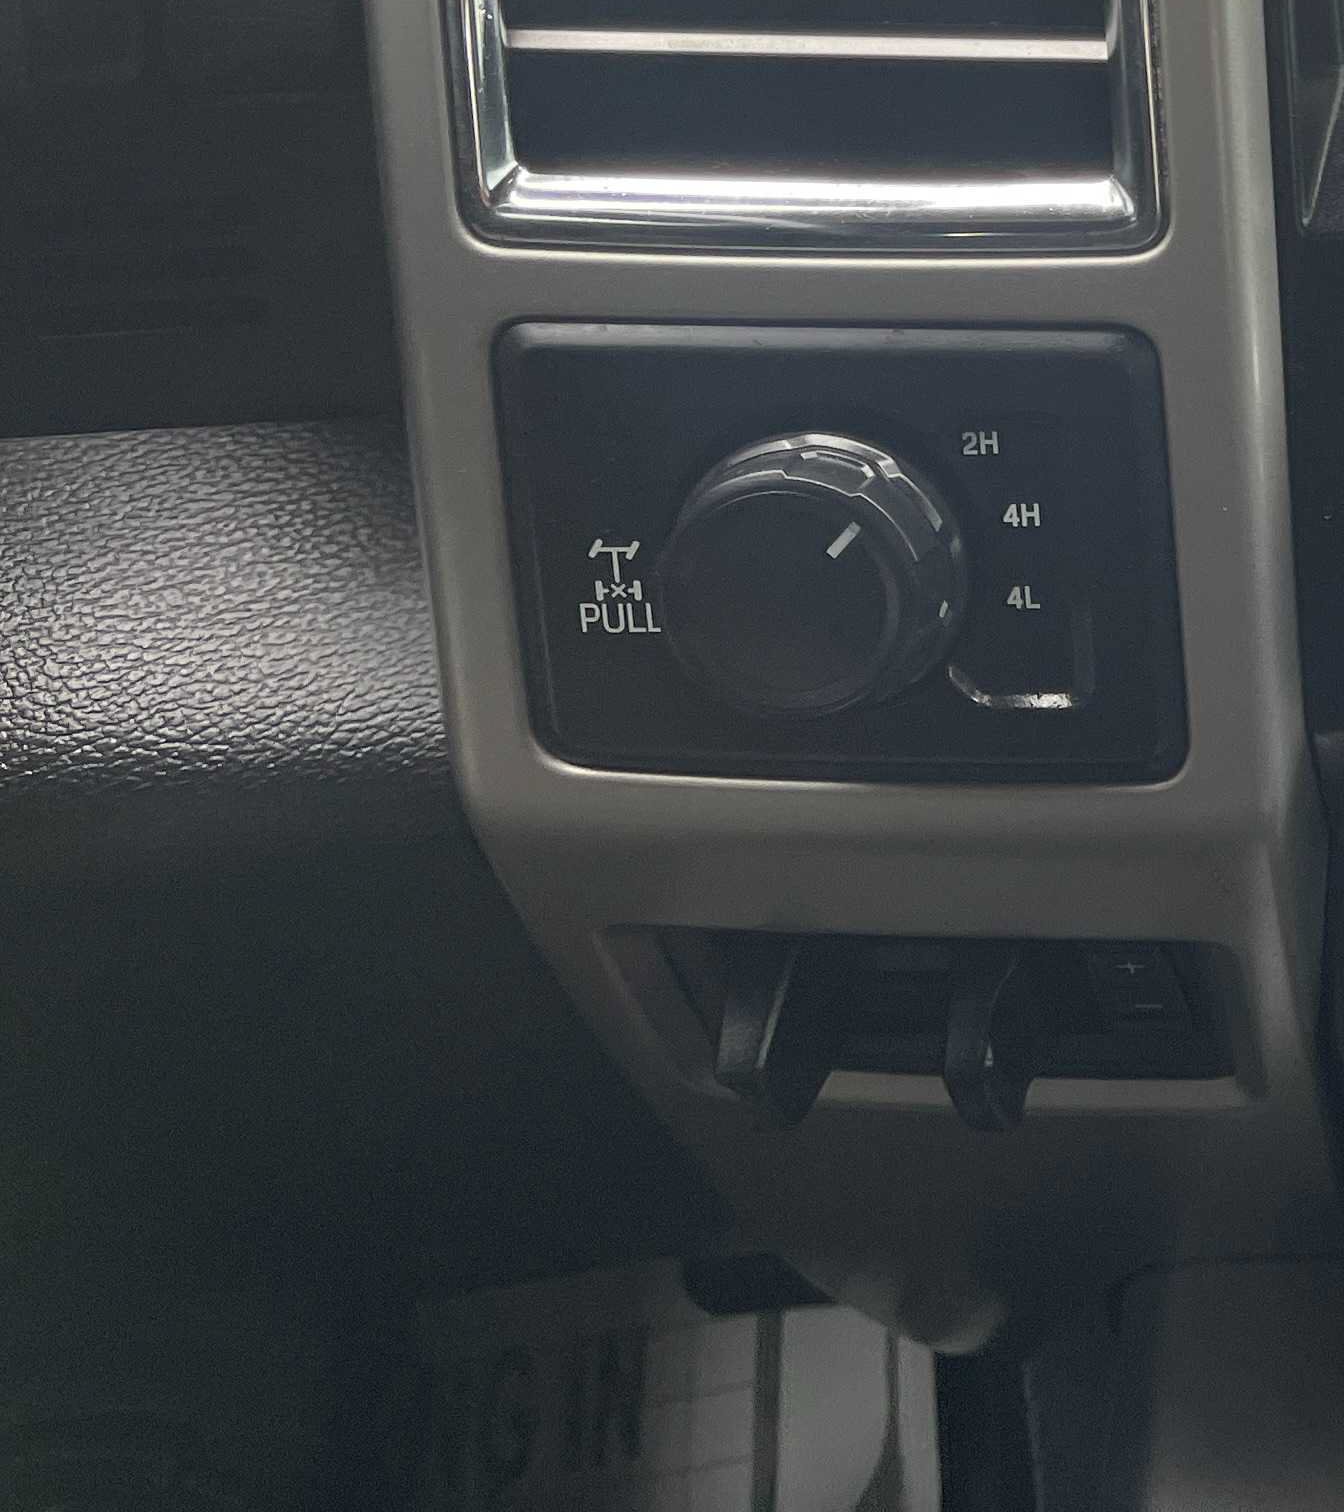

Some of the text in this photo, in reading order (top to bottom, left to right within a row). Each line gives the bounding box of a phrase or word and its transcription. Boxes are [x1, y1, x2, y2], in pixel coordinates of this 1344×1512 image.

[961, 432, 999, 456] 2H
[1002, 504, 1041, 527] 4H
[1006, 586, 1041, 610] 4L
[579, 603, 661, 633] PULL
